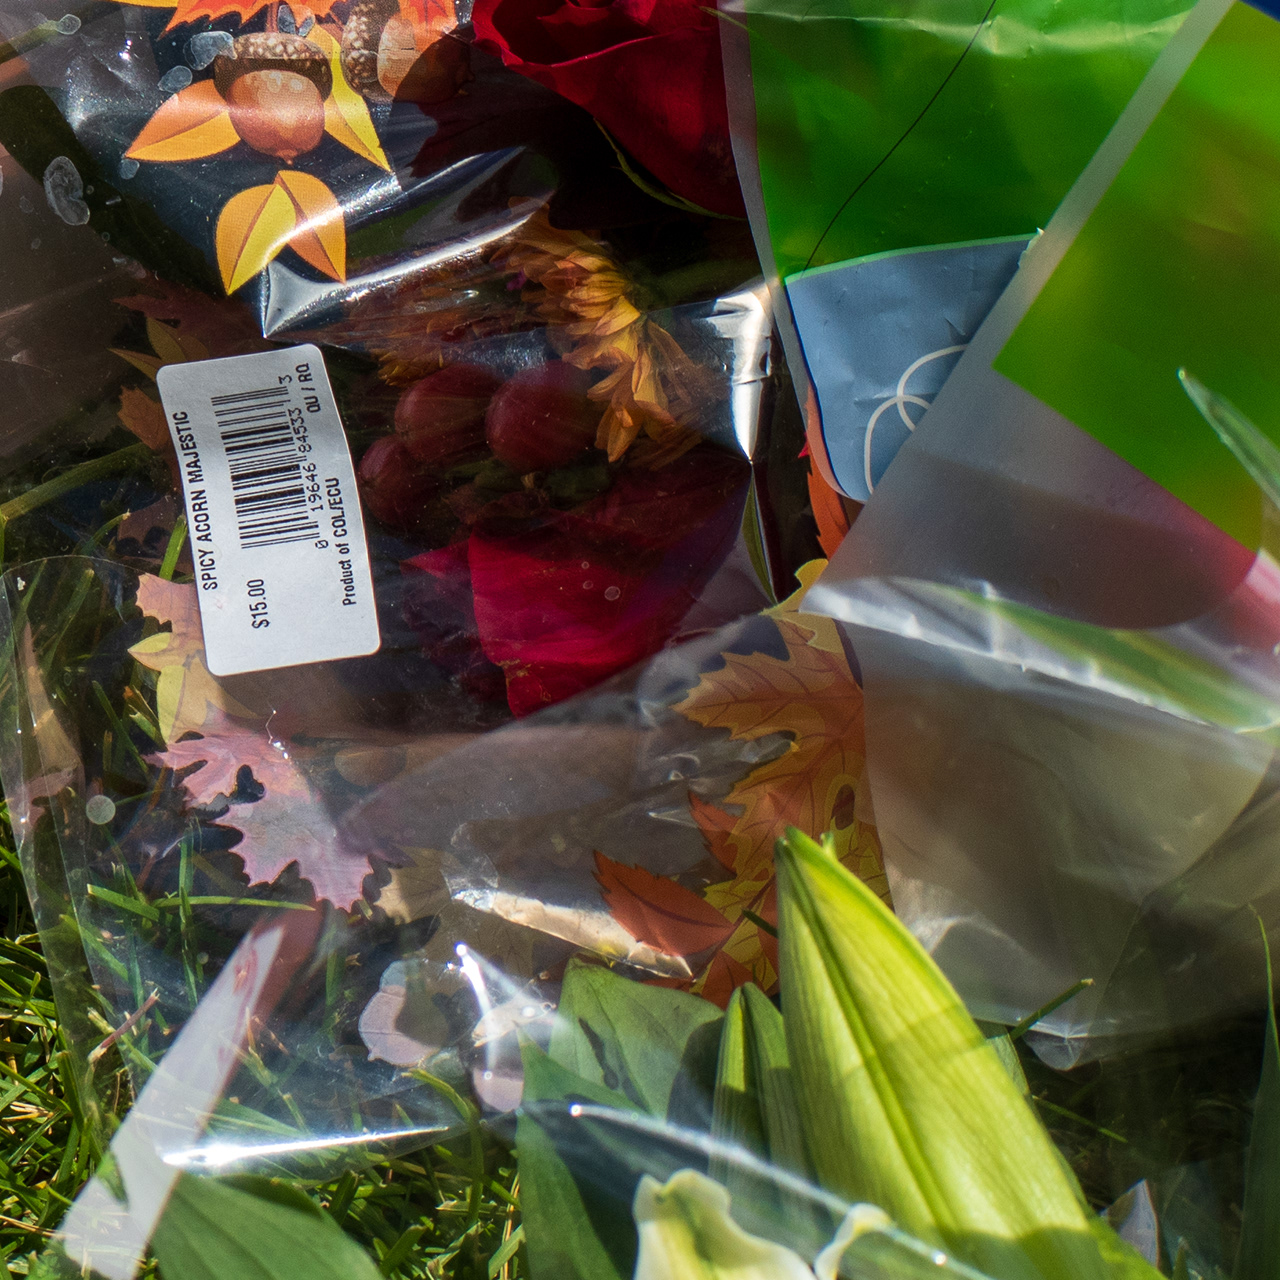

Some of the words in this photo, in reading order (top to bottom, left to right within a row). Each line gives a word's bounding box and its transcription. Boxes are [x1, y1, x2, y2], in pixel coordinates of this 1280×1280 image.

[279, 374, 293, 385] 3
[172, 411, 205, 484] MAJESTIC
[287, 407, 312, 453] 84533
[303, 462, 323, 512] 19646
[325, 477, 348, 537] COL/ECU
[190, 489, 213, 542] ACORN
[198, 548, 219, 591] SPICY
[338, 542, 350, 554] of
[247, 579, 271, 629] $15.00
[338, 560, 357, 606] Product
